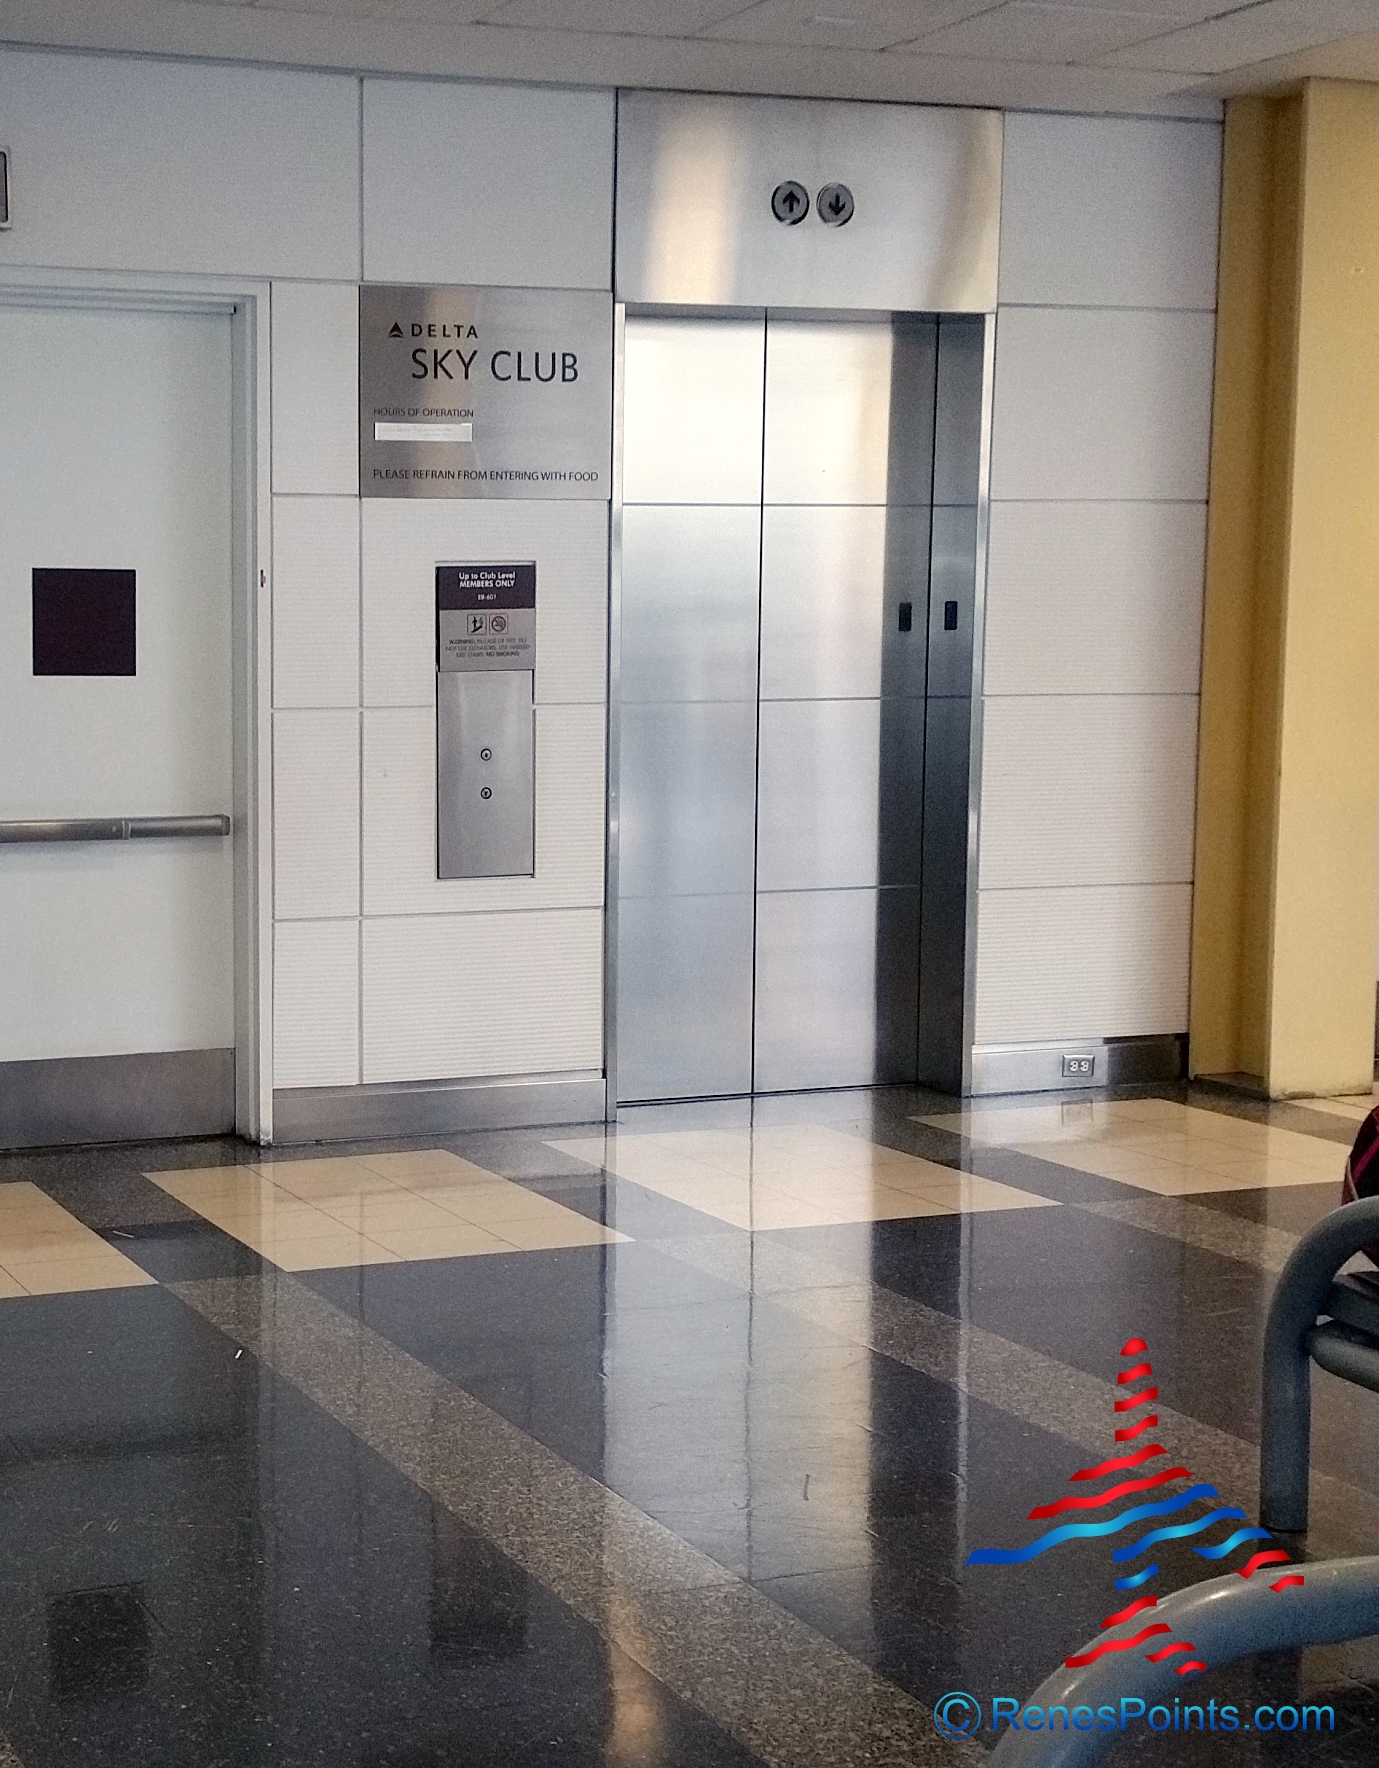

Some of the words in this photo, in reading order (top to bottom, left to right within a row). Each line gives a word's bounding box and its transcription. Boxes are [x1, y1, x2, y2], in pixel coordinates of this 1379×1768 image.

[411, 323, 479, 339] DELTA
[411, 348, 478, 381] SKY
[490, 350, 579, 383] CLUB
[374, 408, 406, 417] HOURS
[408, 408, 420, 417] OF
[422, 408, 474, 418] OPERATION
[373, 469, 410, 479] PLEASE
[413, 469, 455, 480] REFRAIN
[458, 470, 488, 480] FROM
[490, 470, 539, 481] ENTERING
[541, 471, 567, 481] WITH
[569, 471, 598, 482] FOOD
[459, 572, 469, 580] Up
[480, 571, 496, 579] Club
[498, 571, 516, 579] Level
[459, 580, 493, 588] MEMBERS
